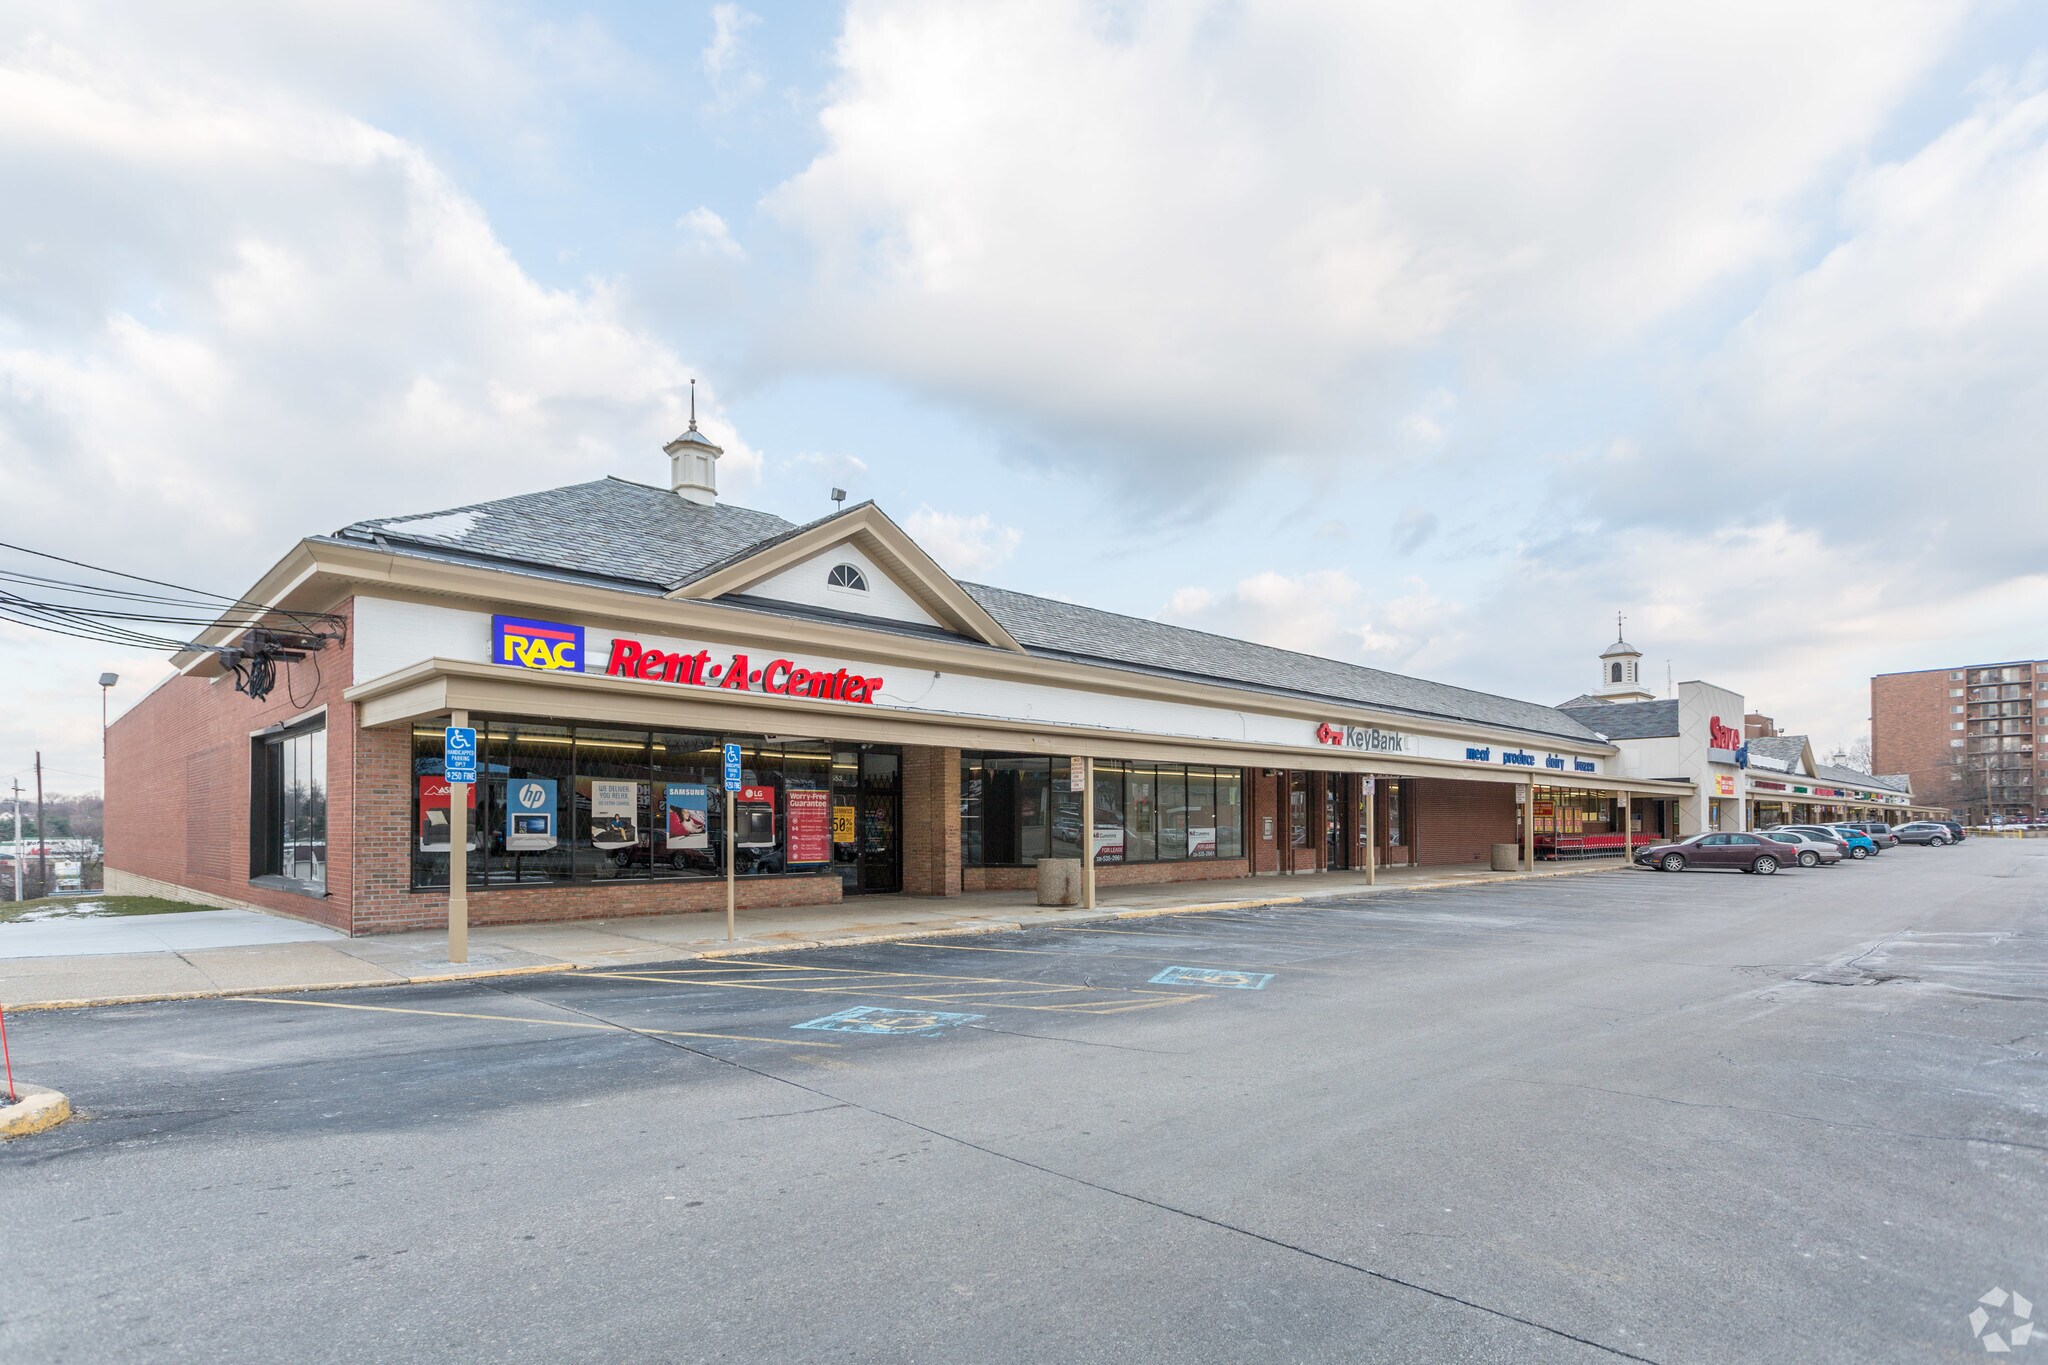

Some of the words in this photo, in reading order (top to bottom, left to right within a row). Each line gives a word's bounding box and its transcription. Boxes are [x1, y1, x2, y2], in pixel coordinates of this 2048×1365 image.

[504, 634, 575, 670] RAC
[1345, 725, 1403, 752] KeyBank
[1710, 715, 1740, 751] Save
[1466, 747, 1490, 762] meat
[1502, 749, 1535, 766] produce
[1546, 753, 1565, 771] dairy
[1574, 756, 1595, 772] frozen
[463, 772, 475, 780] FINE
[522, 783, 544, 809] hp
[669, 788, 705, 796] SAMSUNG
[789, 792, 827, 801] Worry-Free
[789, 800, 827, 808] Guarantee
